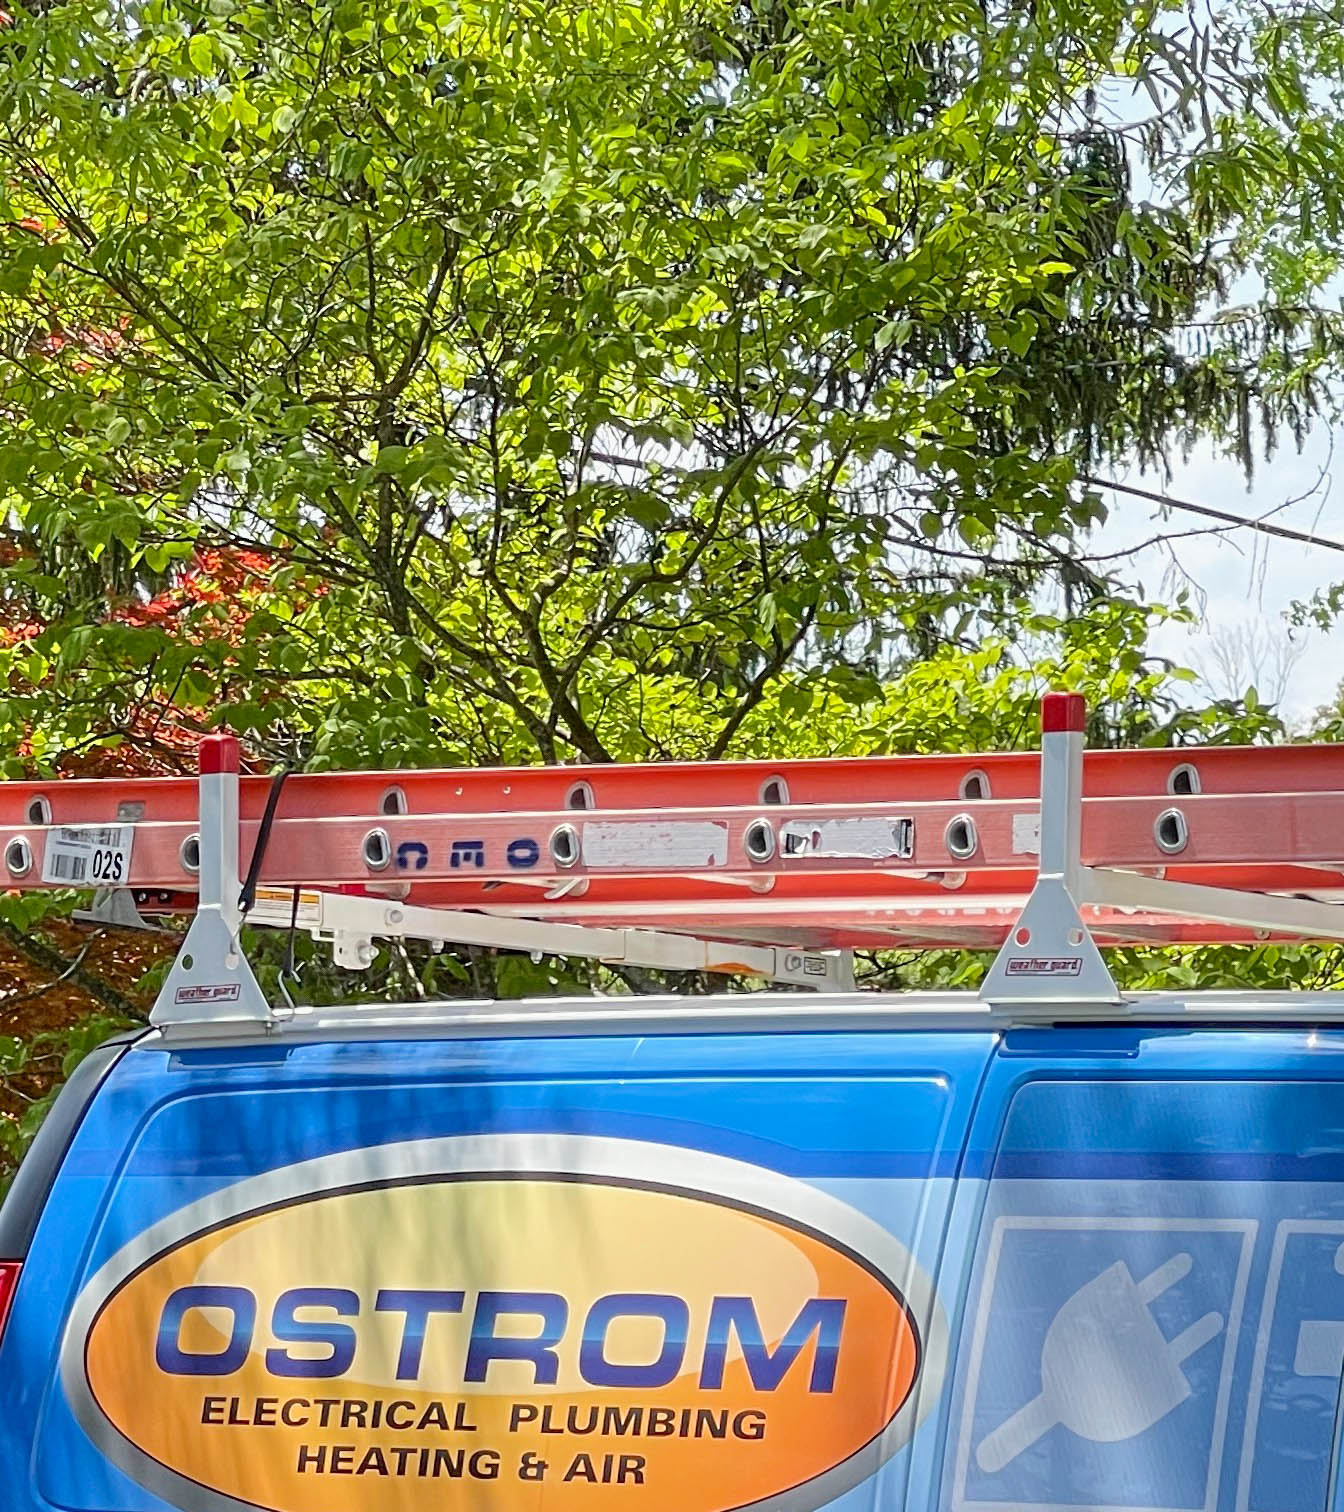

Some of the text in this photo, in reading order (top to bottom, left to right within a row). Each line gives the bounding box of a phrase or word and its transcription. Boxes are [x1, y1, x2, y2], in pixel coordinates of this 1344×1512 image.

[93, 849, 123, 880] 02S
[155, 1285, 849, 1394] OSTROM
[201, 1395, 768, 1441] ELECTRICAL PLUMBING
[297, 1444, 648, 1485] HEATING & AIR
